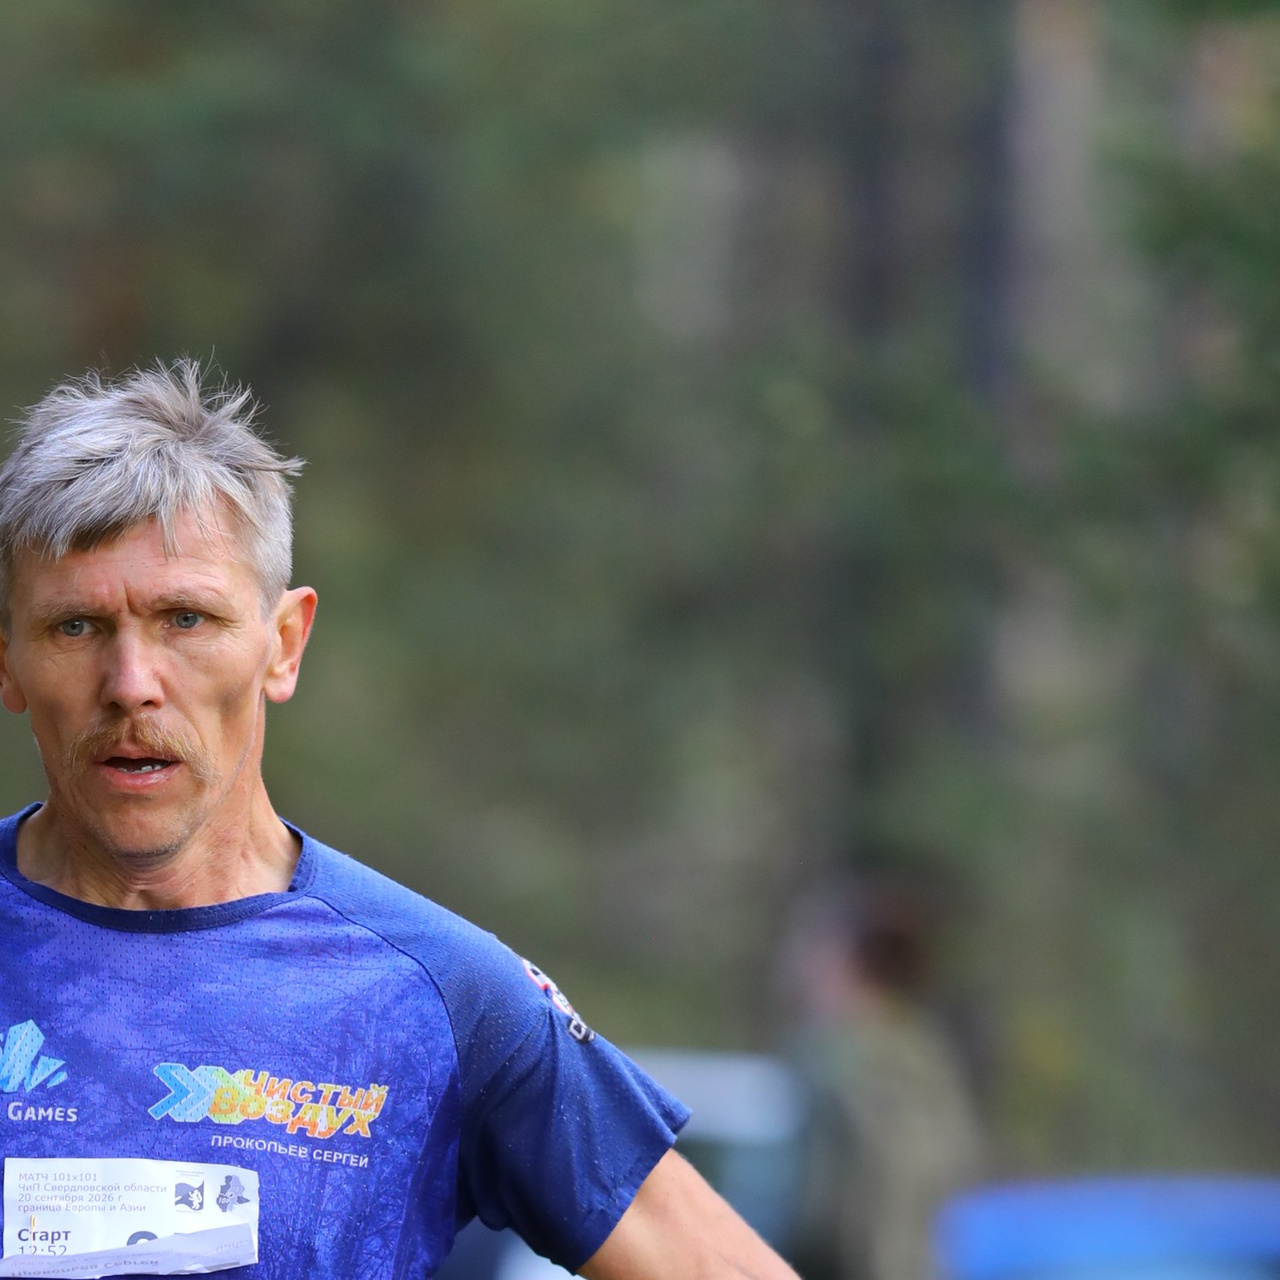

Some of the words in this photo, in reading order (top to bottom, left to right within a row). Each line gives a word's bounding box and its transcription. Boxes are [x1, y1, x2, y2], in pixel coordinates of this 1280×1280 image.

[241, 1069, 389, 1114] ЧИСТЫЙ
[7, 1101, 78, 1122] GAMES
[211, 1135, 309, 1158] ПРОКОПЬЕВ
[312, 1149, 369, 1168] СЕРГЕЙ
[18, 1172, 48, 1182] МАТЧ
[18, 1183, 40, 1192] ЧиП
[44, 1182, 120, 1193] Свердловской
[123, 1183, 167, 1193] области
[18, 1193, 31, 1202] 20
[35, 1193, 84, 1203] сентября
[18, 1204, 61, 1213] граница
[65, 1203, 106, 1213] Европы
[110, 1204, 116, 1212] и
[119, 1203, 146, 1212] Азии
[18, 1228, 71, 1244] Старт
